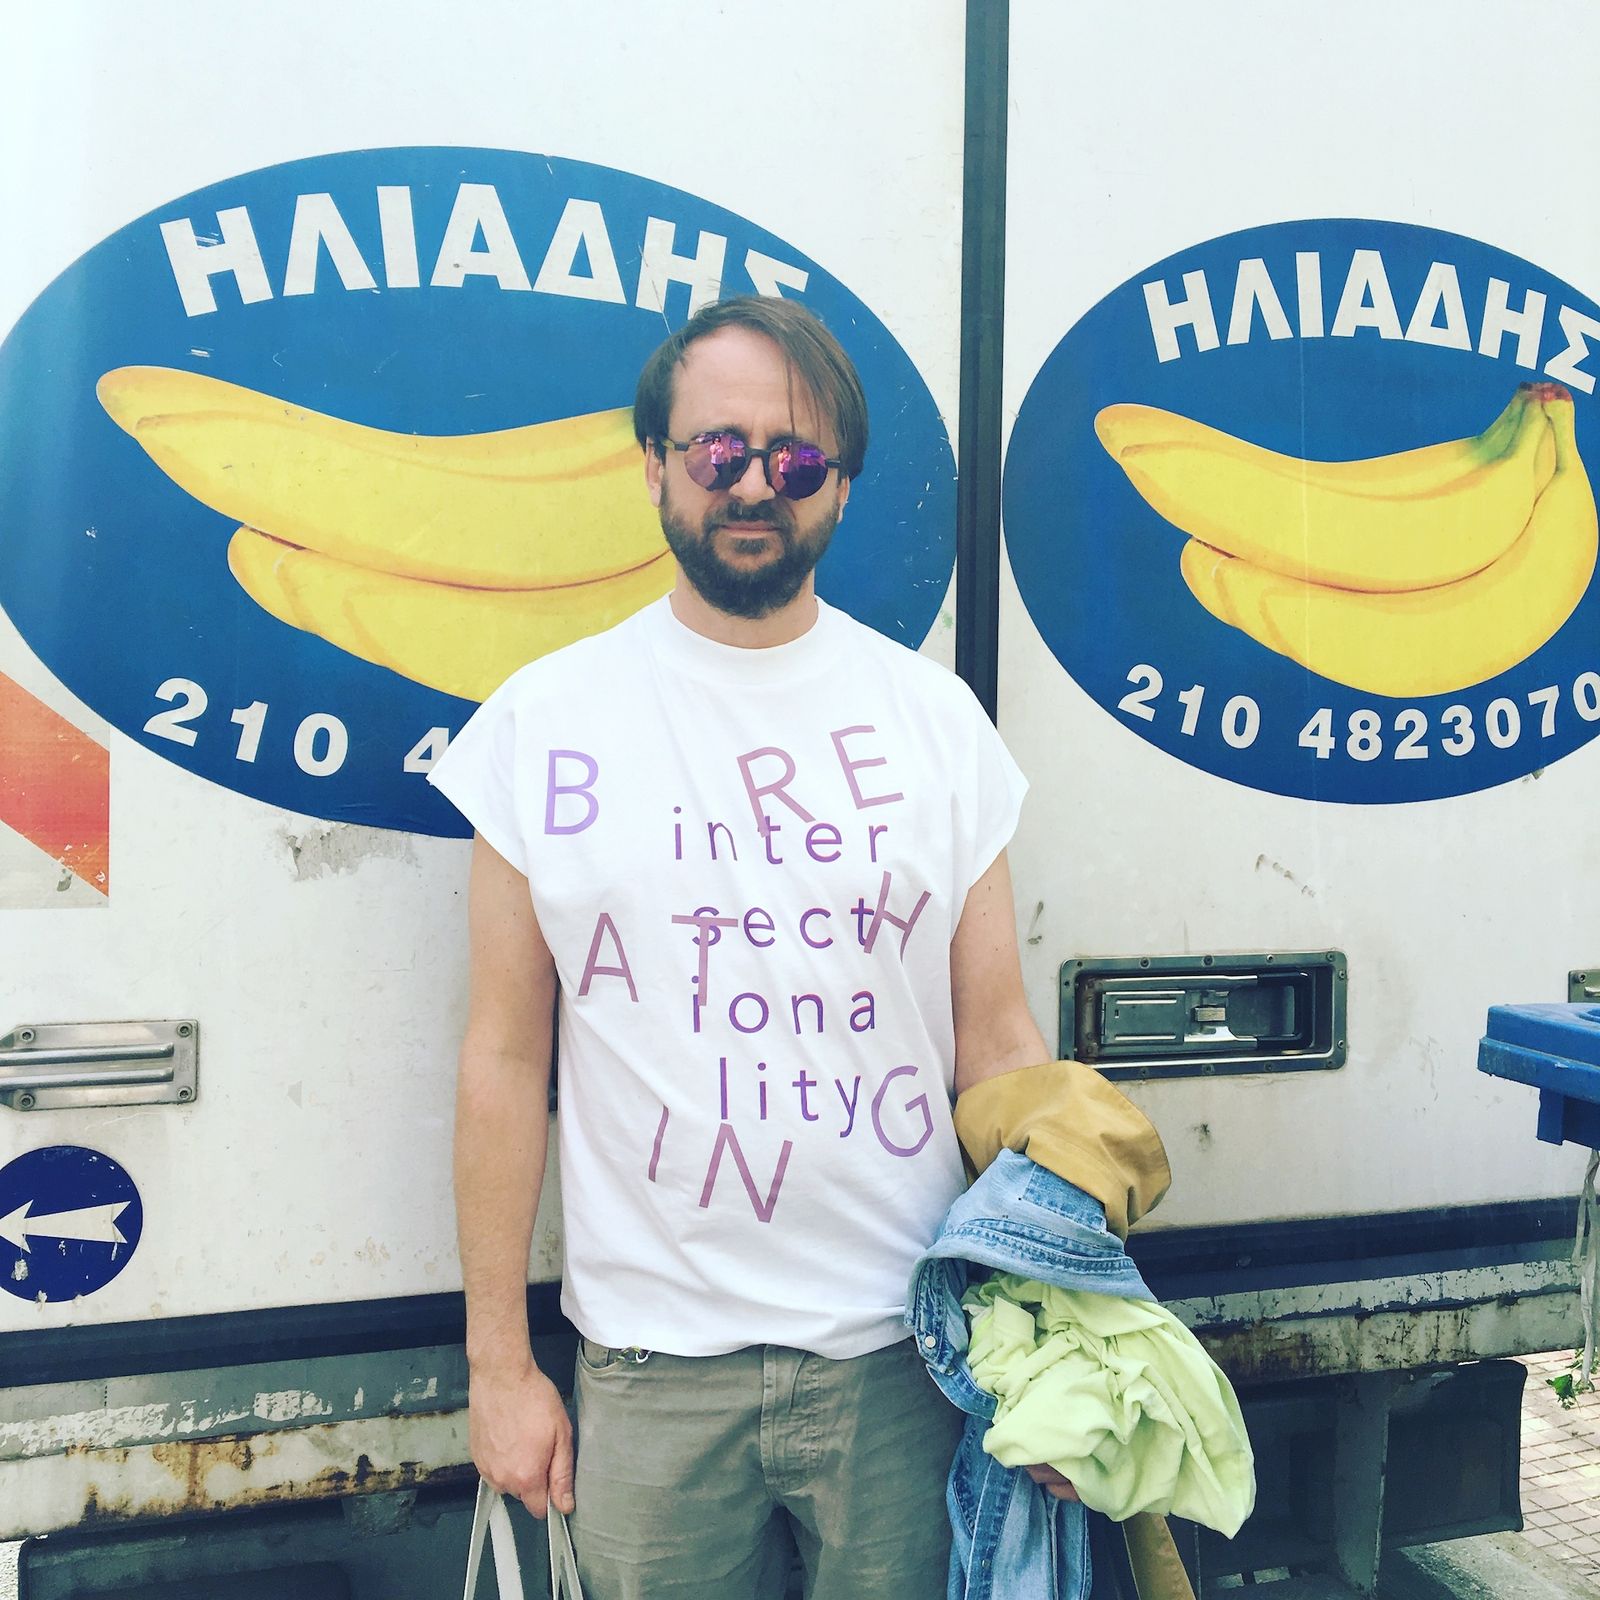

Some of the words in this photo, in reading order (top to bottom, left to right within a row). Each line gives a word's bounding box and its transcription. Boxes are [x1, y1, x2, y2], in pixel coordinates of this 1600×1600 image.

[1143, 249, 1600, 395] ΗΛΙΑΔΗΣ
[143, 677, 349, 777] 210
[1117, 663, 1261, 749] 210
[1298, 671, 1600, 762] 4823070
[674, 806, 889, 865] inter
[690, 975, 876, 1035] iona
[720, 1056, 861, 1138] lity
